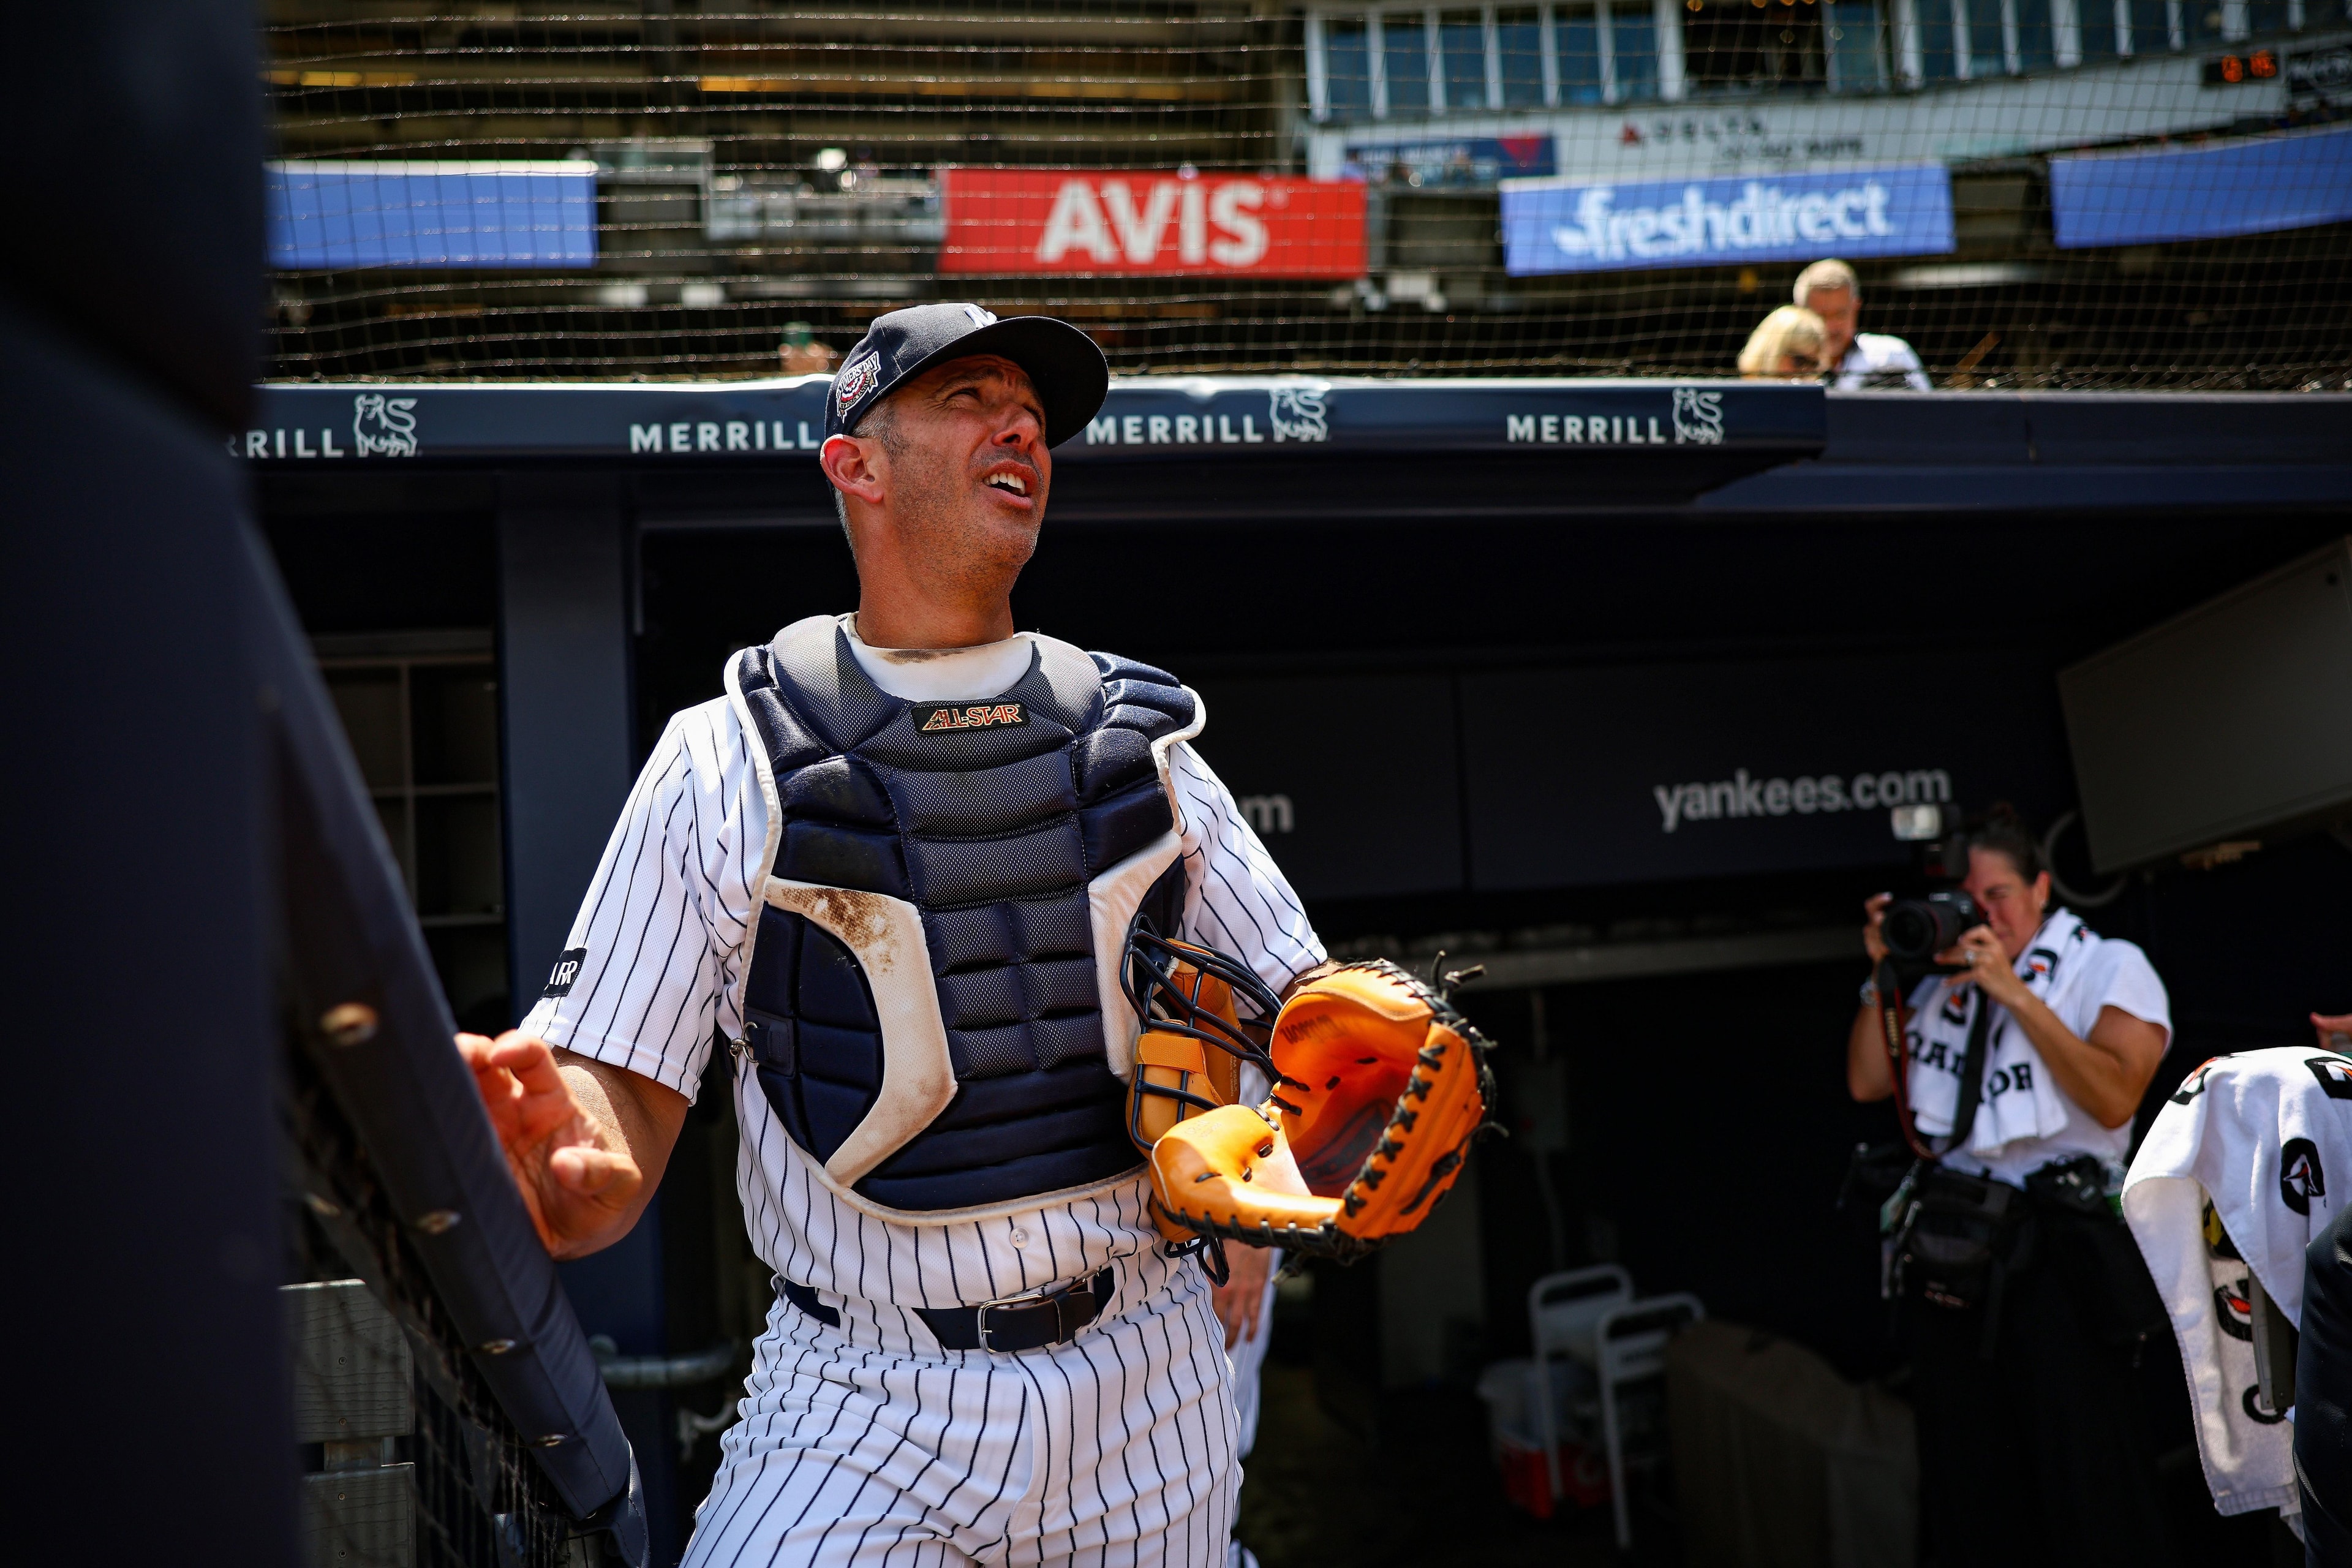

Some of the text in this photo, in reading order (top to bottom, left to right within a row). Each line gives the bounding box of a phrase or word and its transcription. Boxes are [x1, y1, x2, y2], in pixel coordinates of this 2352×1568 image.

[1036, 178, 1270, 266] AVIS
[1551, 179, 1894, 261] freshdirect
[863, 355, 878, 371] DAY
[630, 420, 820, 453] MERRILL
[1086, 414, 1264, 445] MERRILL
[1507, 414, 1667, 444] MERRILL
[922, 705, 1022, 731] ALL-STAR
[1655, 767, 1951, 833] yankees.com
